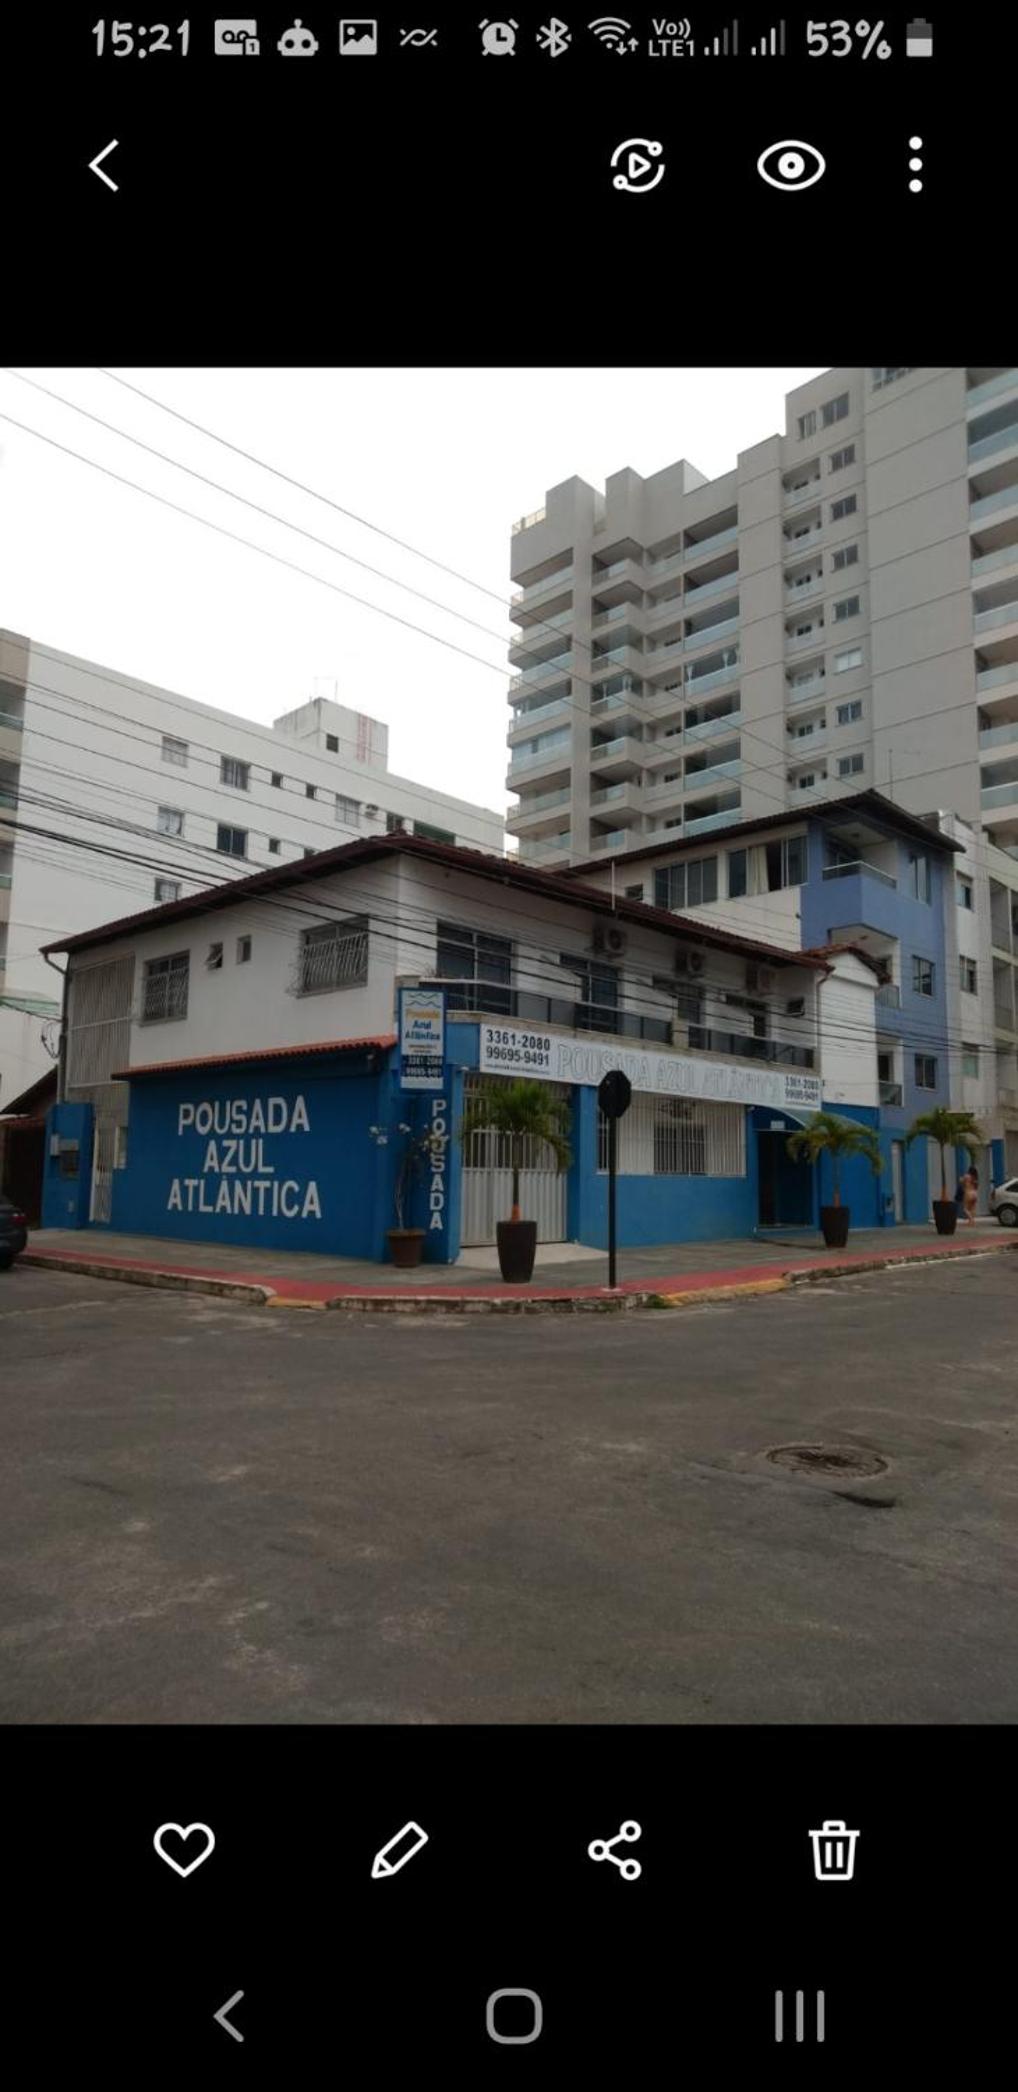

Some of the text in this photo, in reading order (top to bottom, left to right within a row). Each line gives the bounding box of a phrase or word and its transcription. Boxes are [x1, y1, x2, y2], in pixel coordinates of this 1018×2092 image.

[486, 1029, 550, 1051] 3361-2080
[486, 1046, 549, 1067] 99695-9491
[178, 1095, 310, 1136] POUSADA
[203, 1138, 275, 1173] AZUL
[429, 1099, 447, 1230] POUSADA
[167, 1175, 322, 1219] ATLÂNTICA
